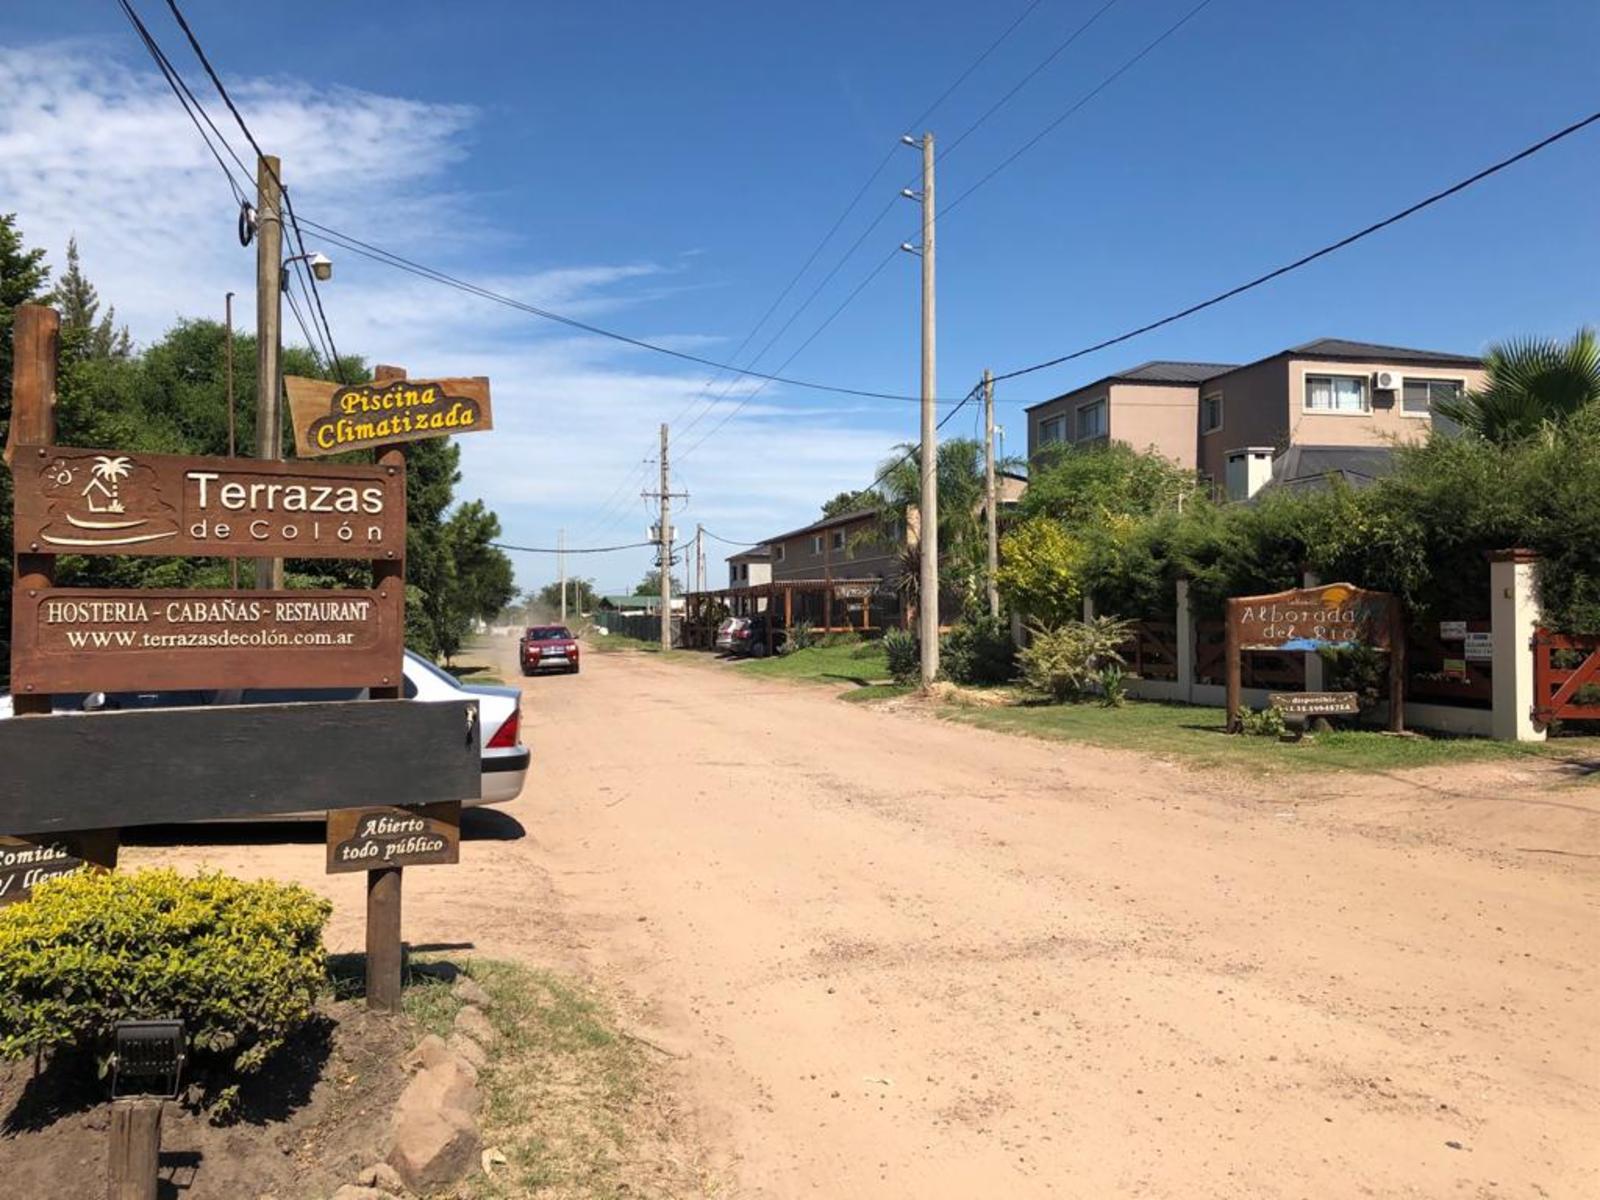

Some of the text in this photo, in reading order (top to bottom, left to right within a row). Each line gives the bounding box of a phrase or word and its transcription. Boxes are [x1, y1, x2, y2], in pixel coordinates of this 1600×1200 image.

[341, 386, 435, 414] Piscina
[317, 402, 474, 448] Climatizada
[187, 472, 384, 513] Terrazas
[190, 519, 382, 541] de Colón
[48, 602, 149, 623] HOSTERIA
[166, 600, 261, 623] CABAÑAS
[275, 602, 370, 622] RESTAURANT
[1241, 604, 1355, 624] Alborada
[1264, 623, 1295, 639] del
[361, 817, 425, 838] Abierto
[343, 836, 443, 860] todo público
